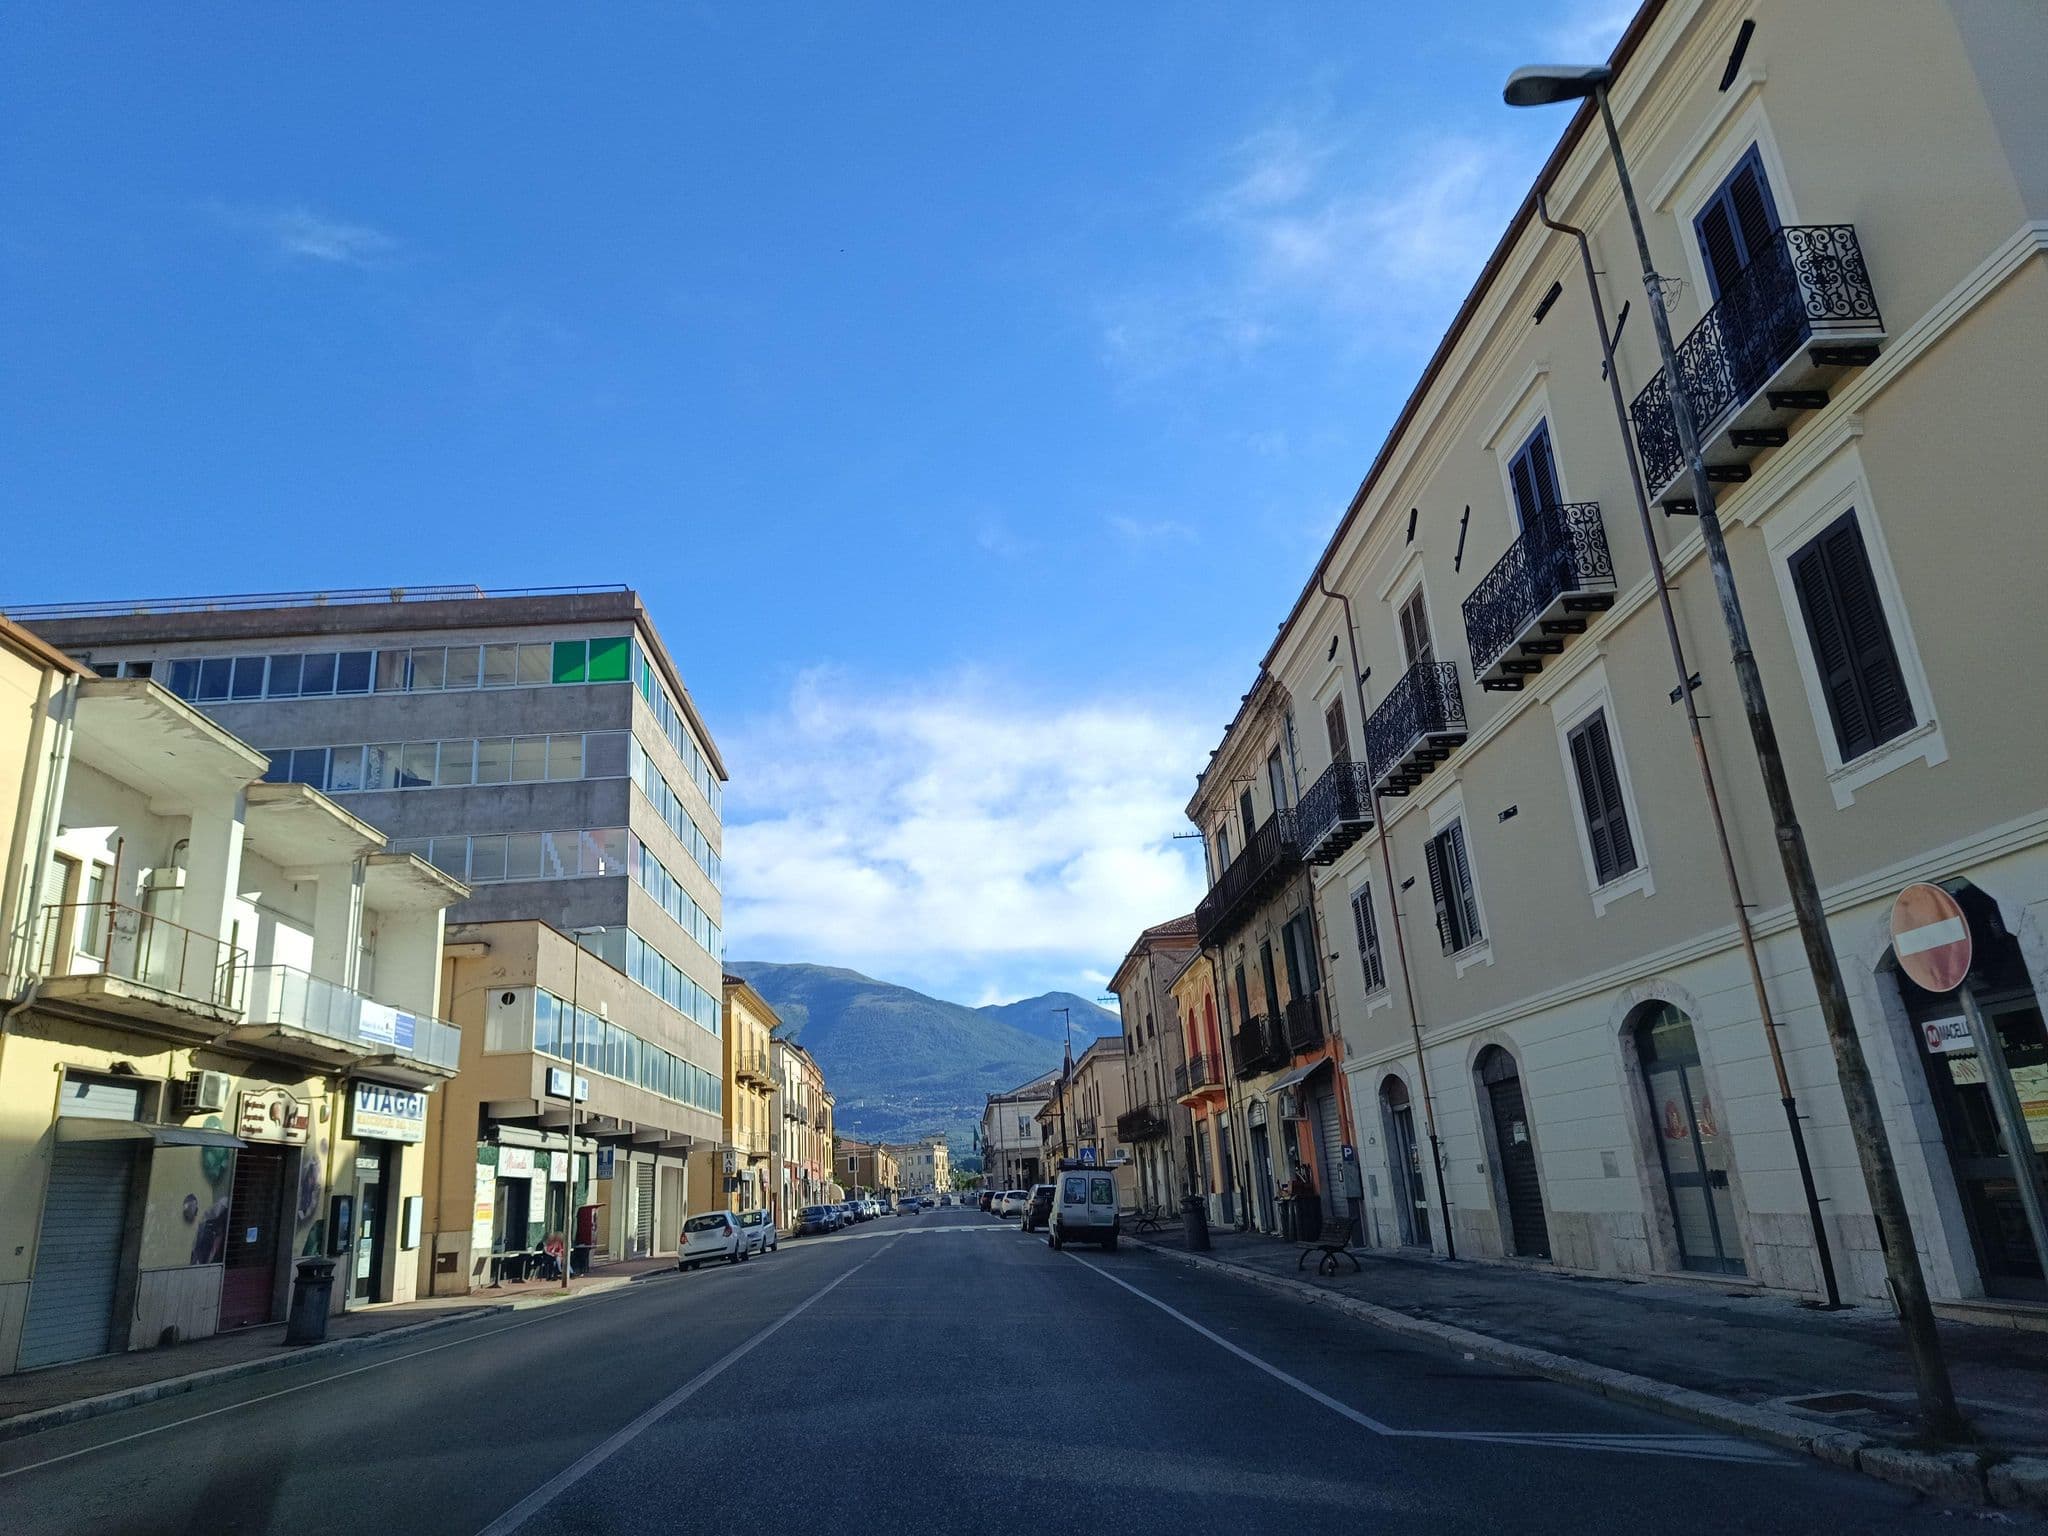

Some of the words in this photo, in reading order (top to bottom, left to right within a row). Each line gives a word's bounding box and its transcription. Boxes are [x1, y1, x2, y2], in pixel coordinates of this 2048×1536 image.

[1938, 1021, 1971, 1040] MACELL
[360, 1084, 424, 1117] VIAGGI
[725, 1152, 733, 1173] BAR
[1343, 1147, 1353, 1158] P
